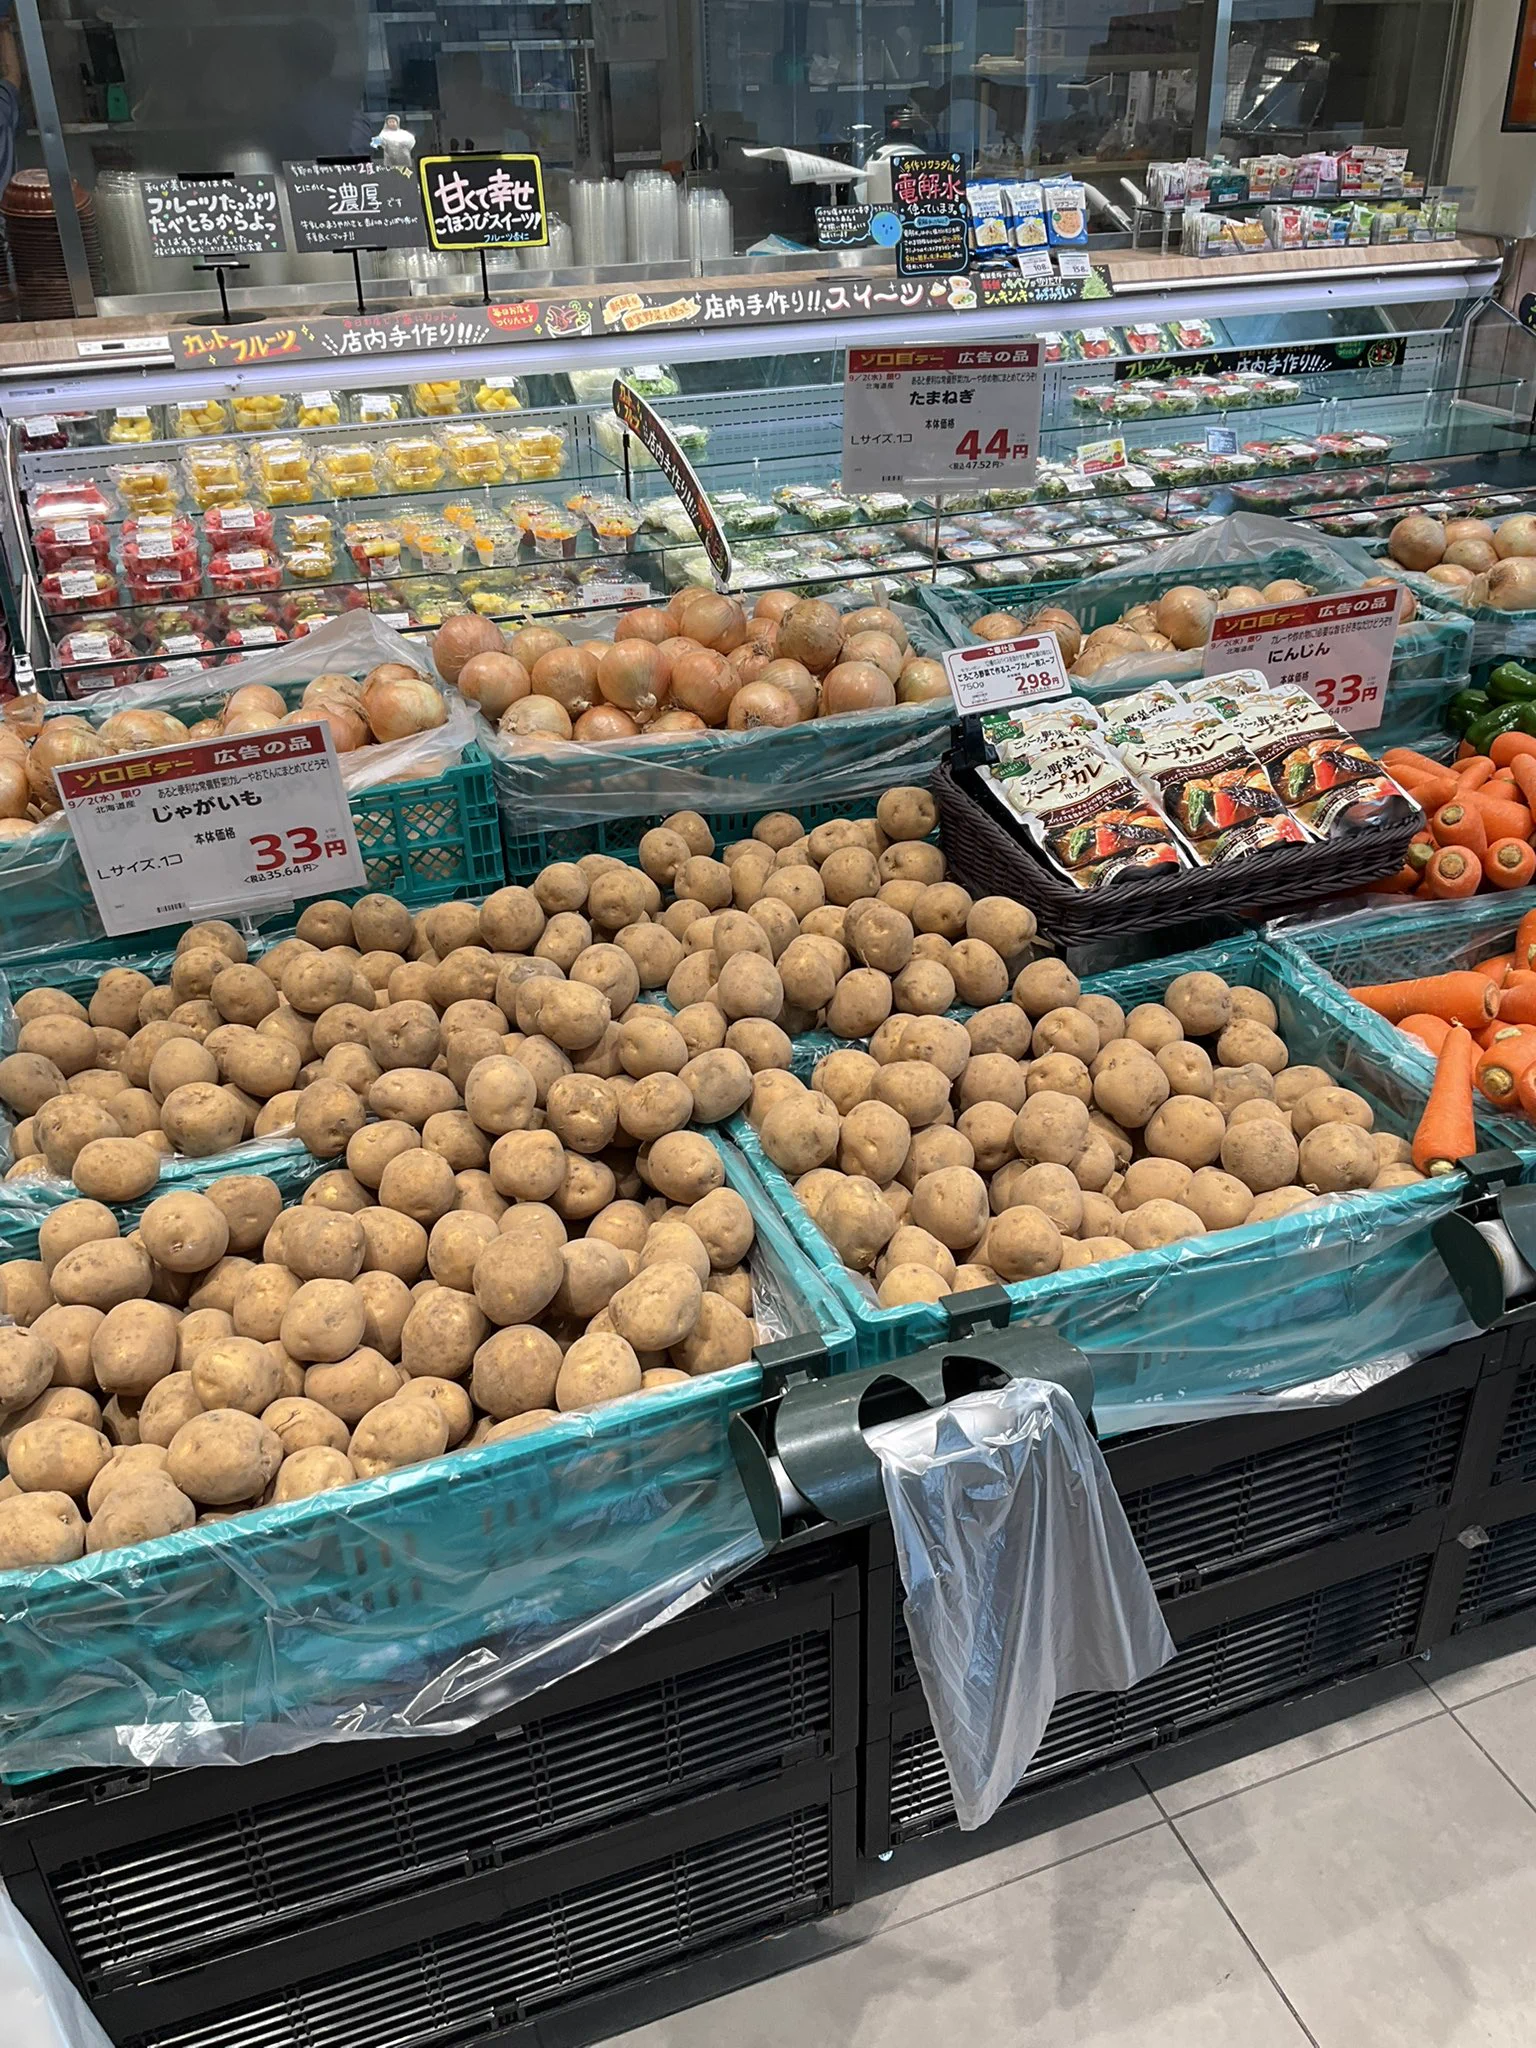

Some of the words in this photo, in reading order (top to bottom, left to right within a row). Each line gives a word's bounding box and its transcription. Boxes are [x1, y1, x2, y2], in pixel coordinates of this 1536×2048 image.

[434, 168, 535, 214] 甘くて幸せ
[147, 191, 277, 215] フルーツたっぷり
[148, 211, 277, 235] たべとるからよっ
[434, 212, 542, 236] ごほうびスイーツ!
[703, 289, 821, 320] 店内手作り!!
[339, 322, 473, 354] 店内手作り!!
[957, 350, 1030, 365] 広告の品
[909, 389, 976, 406] たまねぎ
[925, 418, 955, 430] 本体価格
[1317, 596, 1388, 619] 広告の品
[1267, 642, 1331, 664] にんじん
[960, 681, 985, 692] 750g
[1280, 671, 1309, 686] 本体価格
[213, 735, 312, 765] 広告の品
[96, 799, 136, 814] 北海道産
[152, 789, 263, 824] じゃがいも
[194, 827, 236, 846] 本体価格
